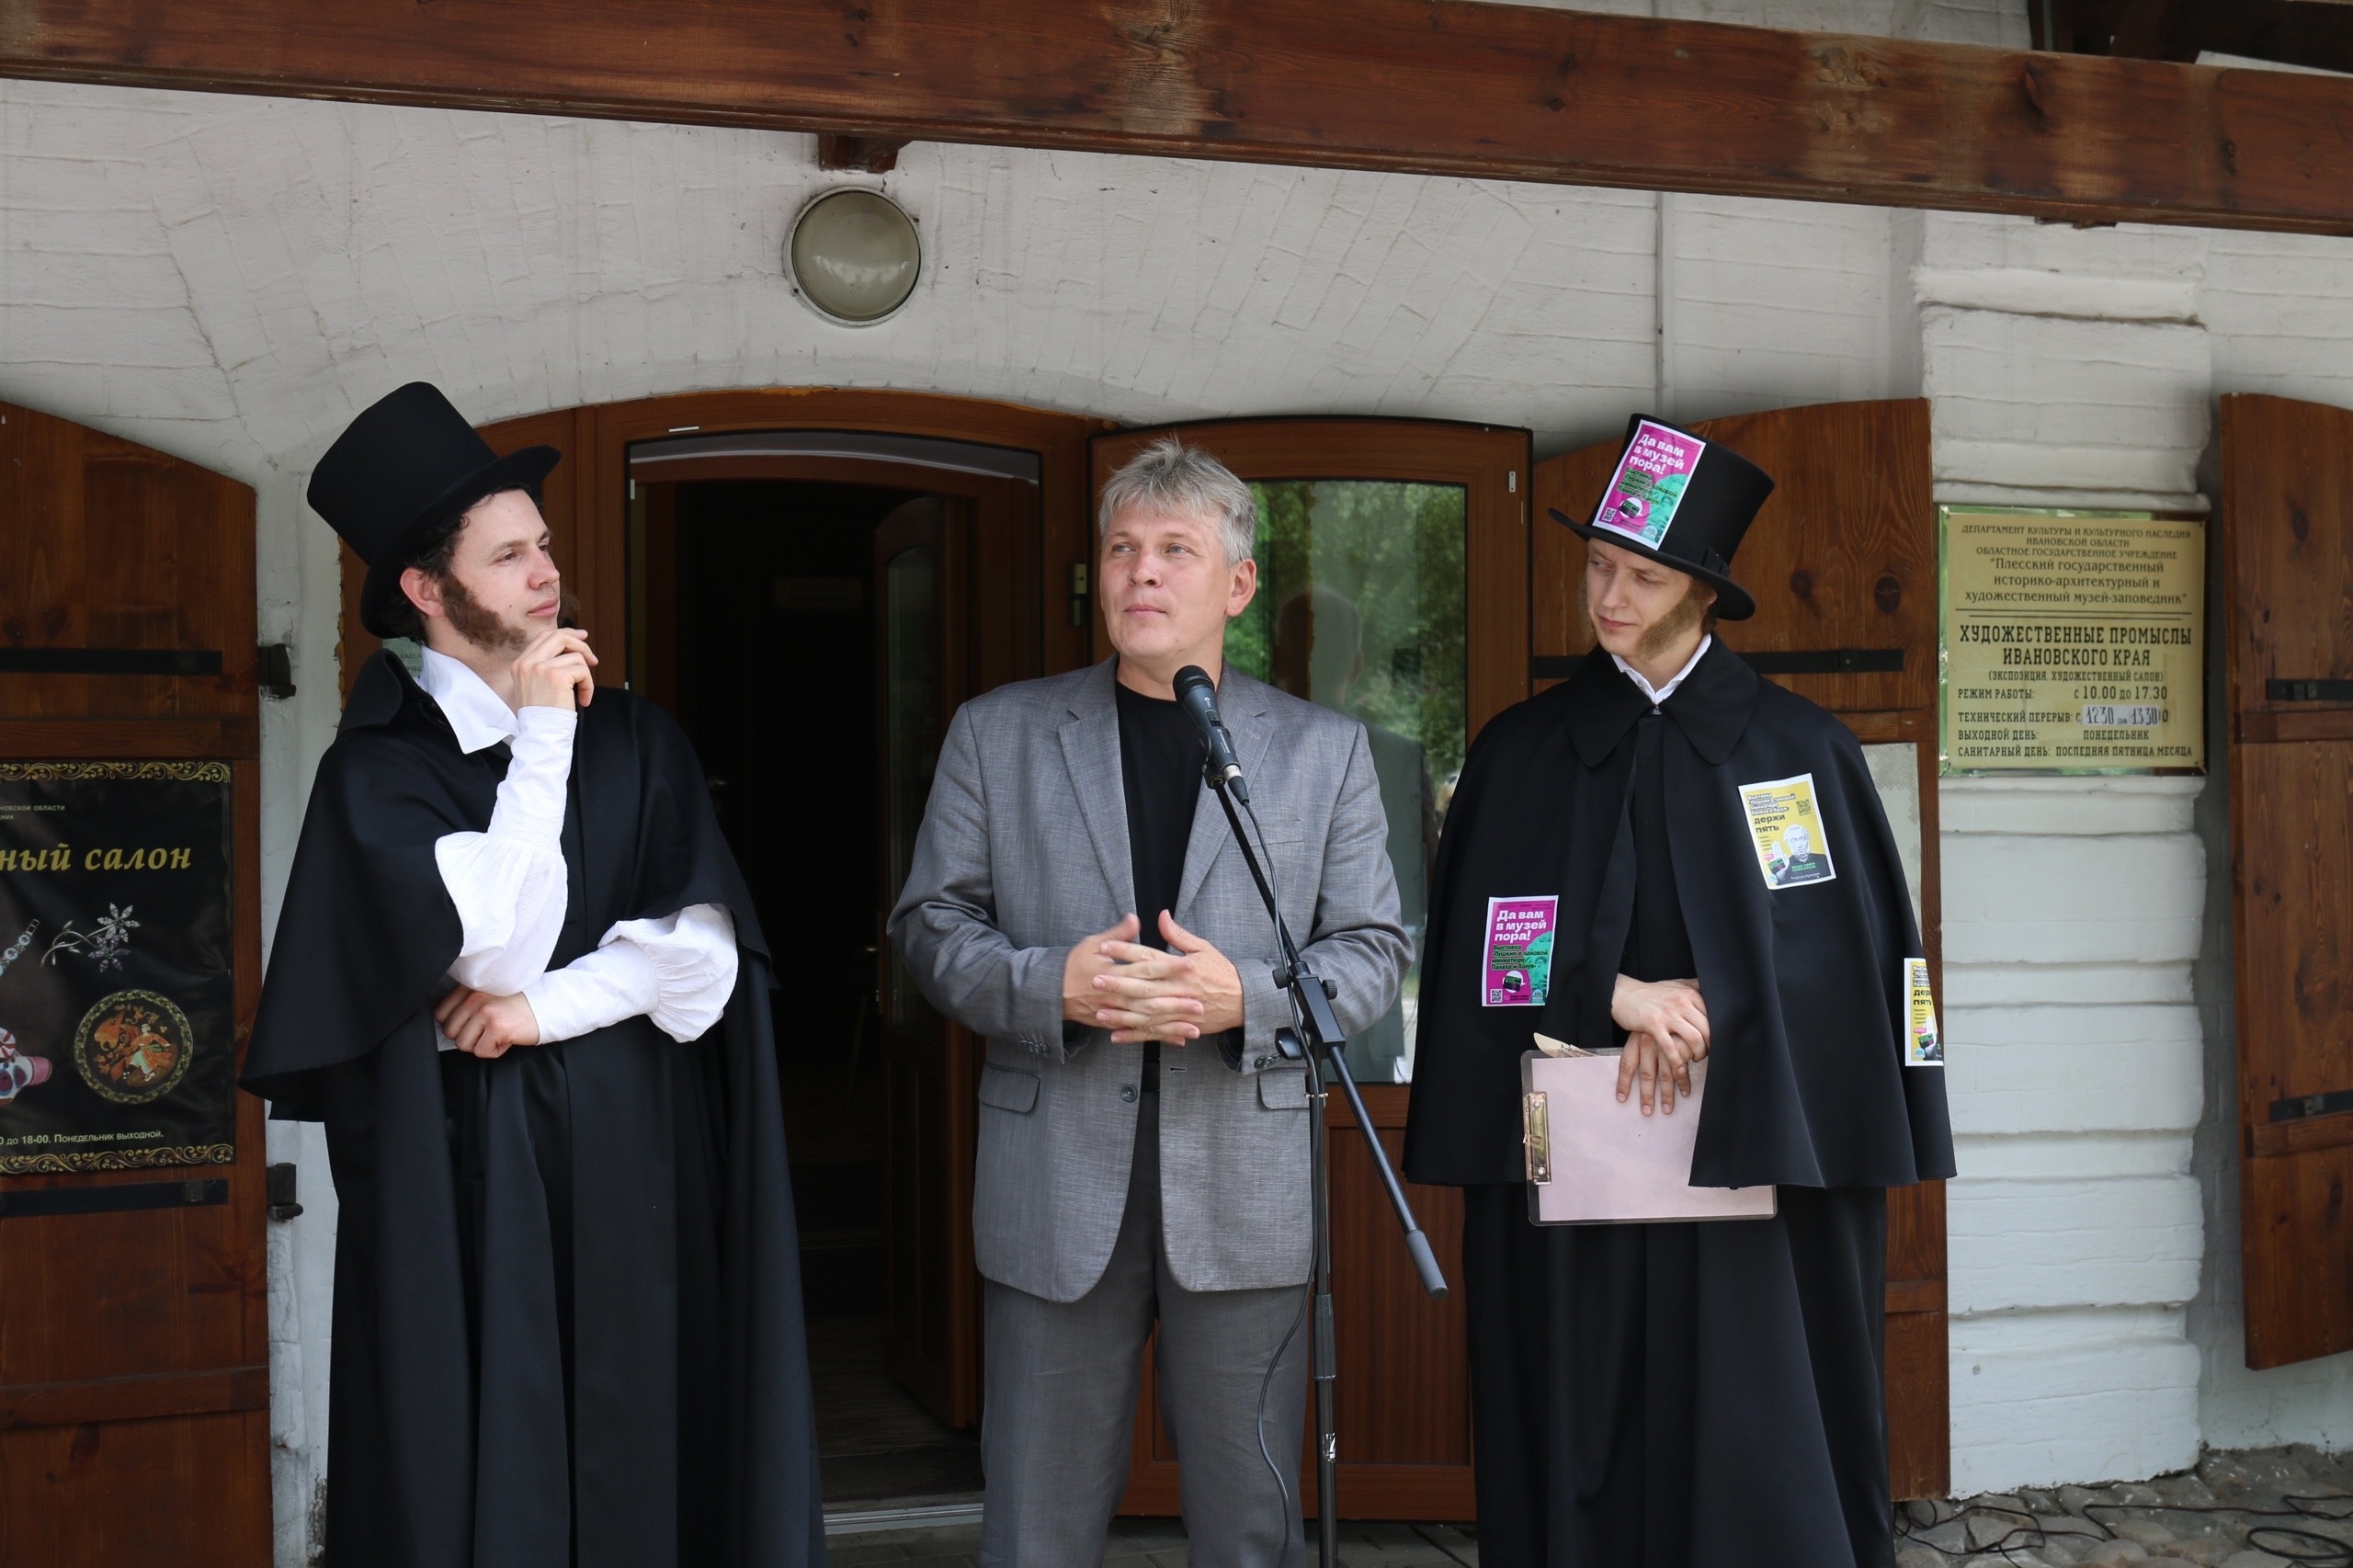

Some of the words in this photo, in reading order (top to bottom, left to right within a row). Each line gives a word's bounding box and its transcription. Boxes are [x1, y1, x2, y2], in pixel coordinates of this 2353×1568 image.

[1638, 434, 1655, 447] Да
[1656, 440, 1684, 457] вам
[1630, 456, 1665, 474] пора!
[1634, 446, 1642, 454] в
[1643, 448, 1684, 471] музей
[1961, 525, 2025, 535] ДЕПАРТАМЕНТ
[2029, 527, 2071, 536] КУЛЬТУРЫ
[2146, 530, 2190, 539] НАСЛЕДИЯ
[2027, 538, 2086, 546] ИВАНОВСКОЙ
[1976, 547, 2029, 556] ОБЛАСТНОЕ
[2033, 548, 2116, 557] ГОСУДАРСТВЕННОЕ
[2120, 551, 2177, 560] УЧРЕЖДЕНИЕ
[2059, 562, 2164, 574] государственный
[1995, 575, 2148, 589] историко-архитектурный
[2153, 580, 2160, 588] и
[1965, 590, 2070, 603] художественный
[1960, 625, 2104, 644] ХУДОЖЕСТВЕННЫЕ
[2109, 627, 2192, 644] ПРОМЫСЛЫ
[2003, 648, 2108, 665] ИВАНОВСКОГО
[2113, 650, 2151, 665] КРАЯ
[2052, 670, 2131, 682] ХУДОЖЕСТВЕННЫЙ
[2133, 672, 2164, 682] САЛОН)
[1958, 689, 1992, 699] РЕЖИМ
[1995, 689, 2035, 699] РАБОТЫ:
[2083, 687, 2116, 699] 10.00
[2135, 687, 2167, 699] 17.30
[1958, 710, 2026, 722] ТЕХНИЧЕСКИЙ
[2029, 712, 2073, 722] ПЕРЕРЫВ:
[2086, 707, 2114, 724] 1230
[2131, 708, 2158, 724] 1330
[1959, 729, 2009, 741] ВЫХОДНОЙ
[2013, 731, 2039, 741] ДЕНЬ:
[2084, 731, 2149, 741] ПОНЕДЕЛЬНИК
[1958, 745, 2021, 756] САНИТАРНЫЙ
[2024, 747, 2050, 757] ДЕНЬ:
[2056, 746, 2109, 756] ПОСЛЕДНЯЯ
[2112, 746, 2154, 757] ПЯТНИЦА
[2157, 747, 2192, 757] МЕСЯЦА
[1754, 814, 1785, 824] держи
[85, 847, 190, 870] салон
[1496, 910, 1516, 922] Да
[1518, 911, 1543, 919] вам
[1506, 919, 1547, 932] музей
[1495, 930, 1531, 943] пора!
[22, 1135, 51, 1144] 18-00.
